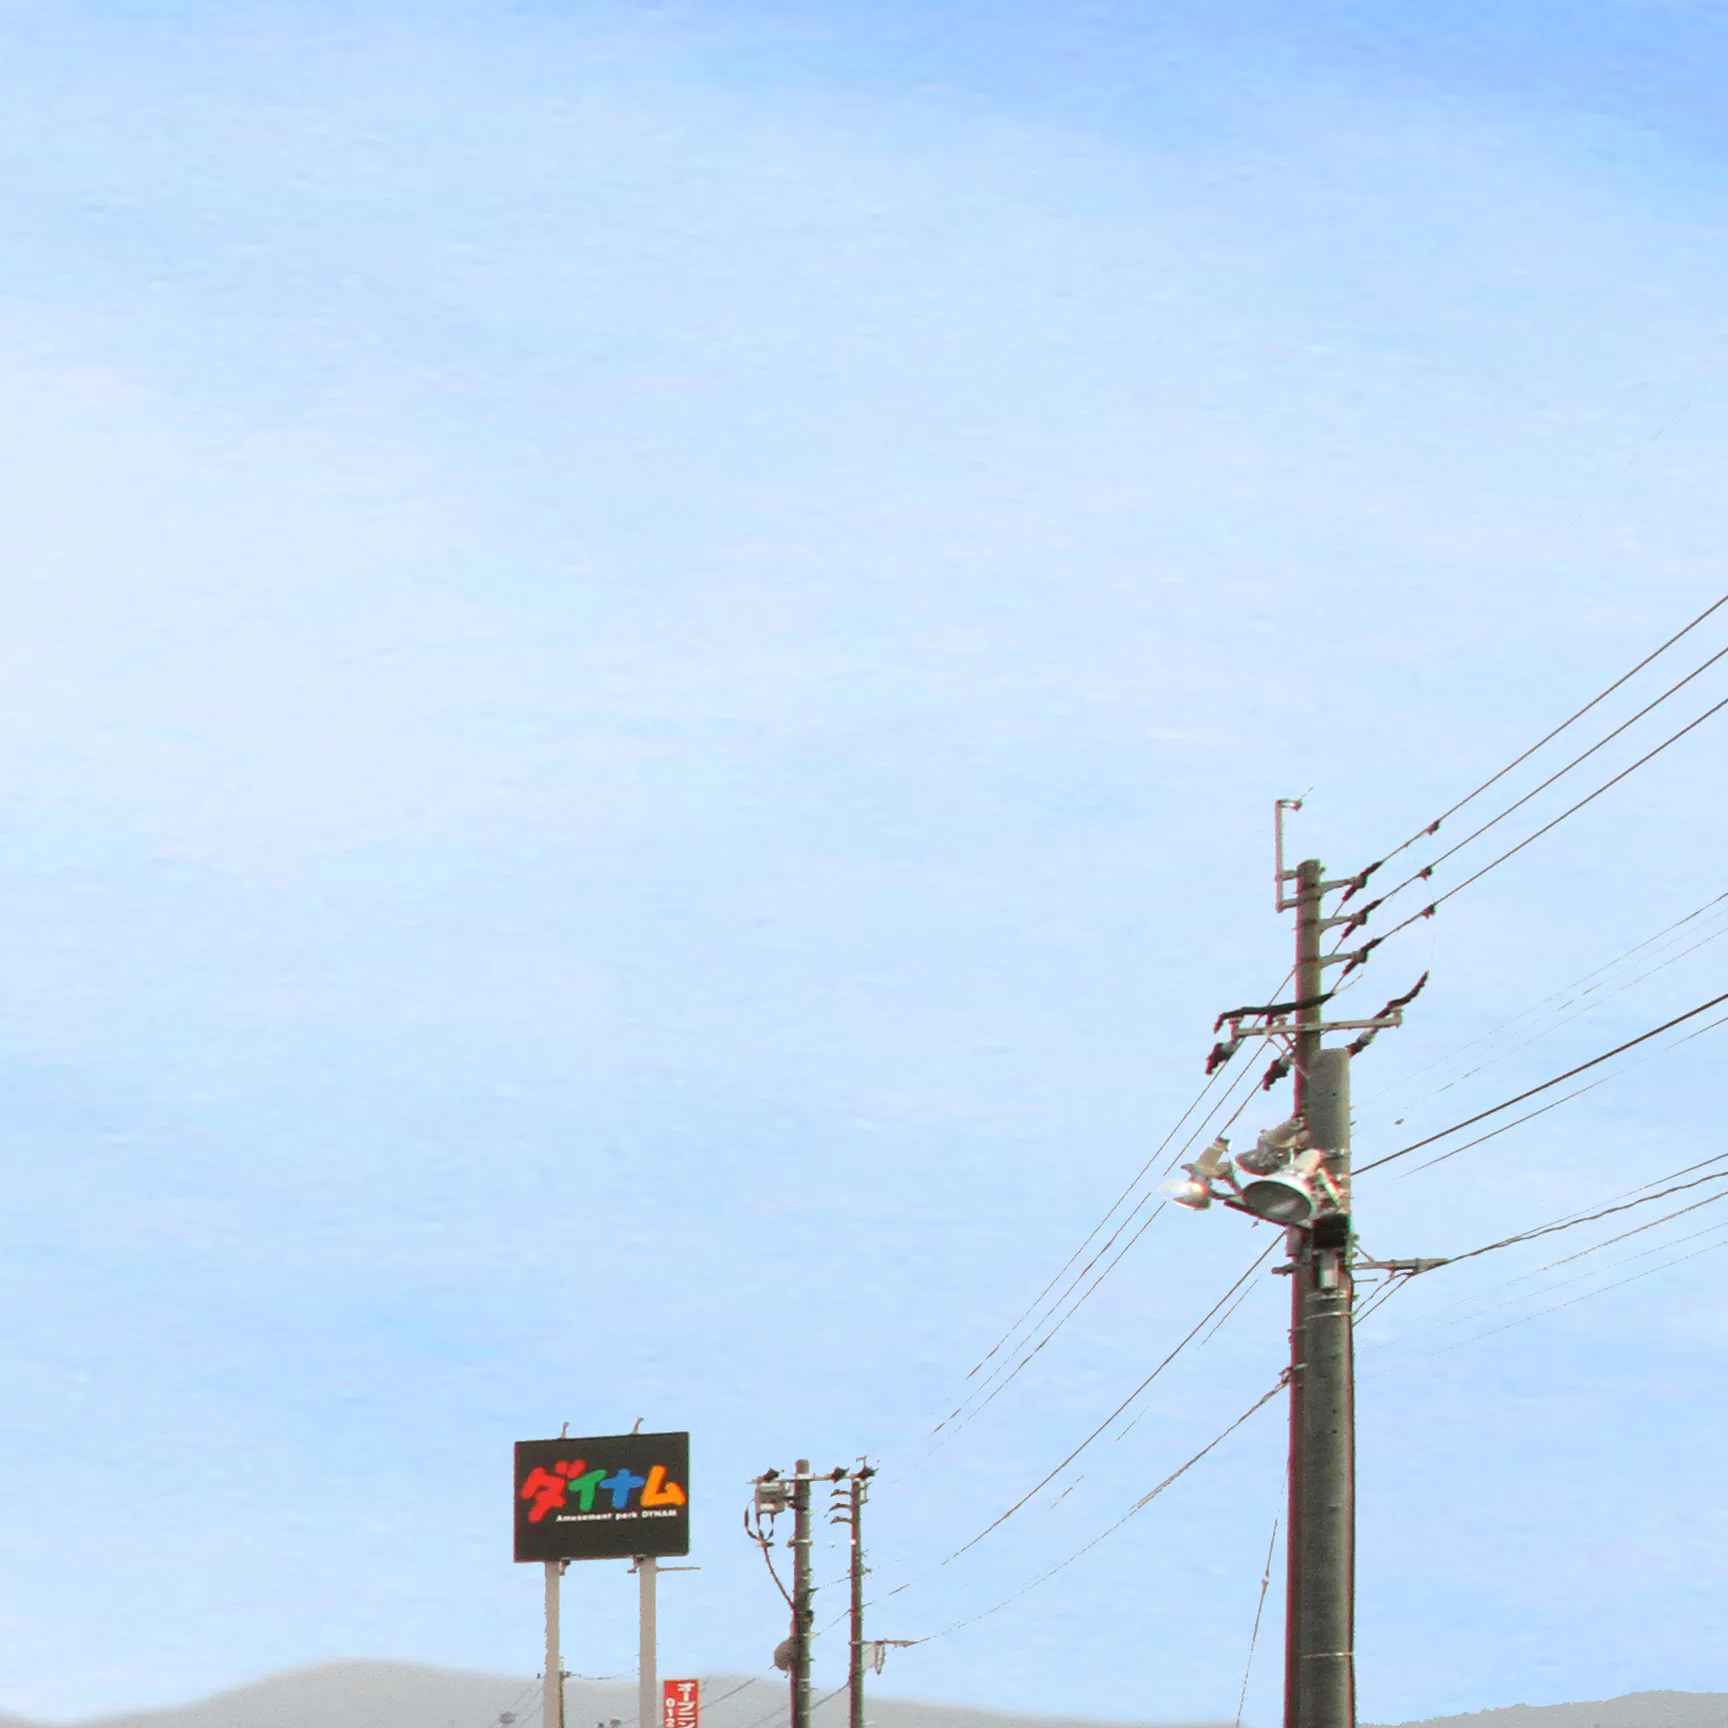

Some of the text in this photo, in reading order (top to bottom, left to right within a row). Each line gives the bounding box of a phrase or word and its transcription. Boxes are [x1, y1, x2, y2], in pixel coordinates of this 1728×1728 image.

[520, 1460, 686, 1522] ダイナム
[556, 1508, 678, 1523] Amusement park DYNAM
